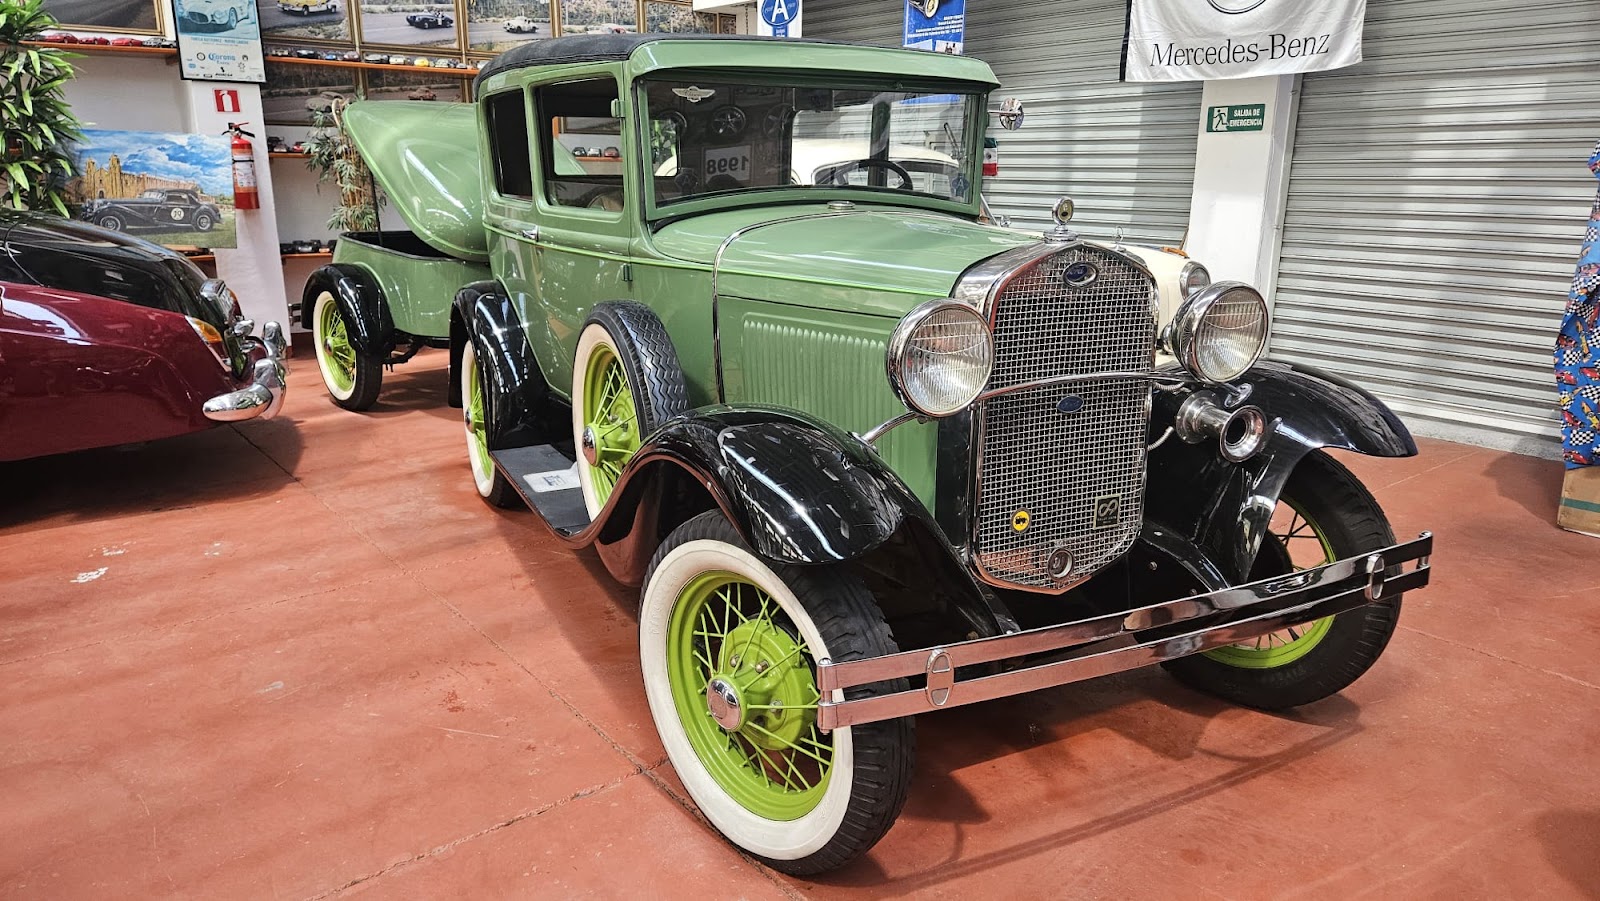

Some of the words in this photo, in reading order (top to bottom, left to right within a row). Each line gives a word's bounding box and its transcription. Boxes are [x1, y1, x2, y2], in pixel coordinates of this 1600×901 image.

[771, 0, 790, 22] A
[1150, 33, 1331, 67] Mercedes-Benz
[208, 52, 236, 61] Corona
[1233, 108, 1252, 117] SALIDA
[1253, 108, 1261, 116] DE
[1229, 118, 1262, 127] EMERGENCIA
